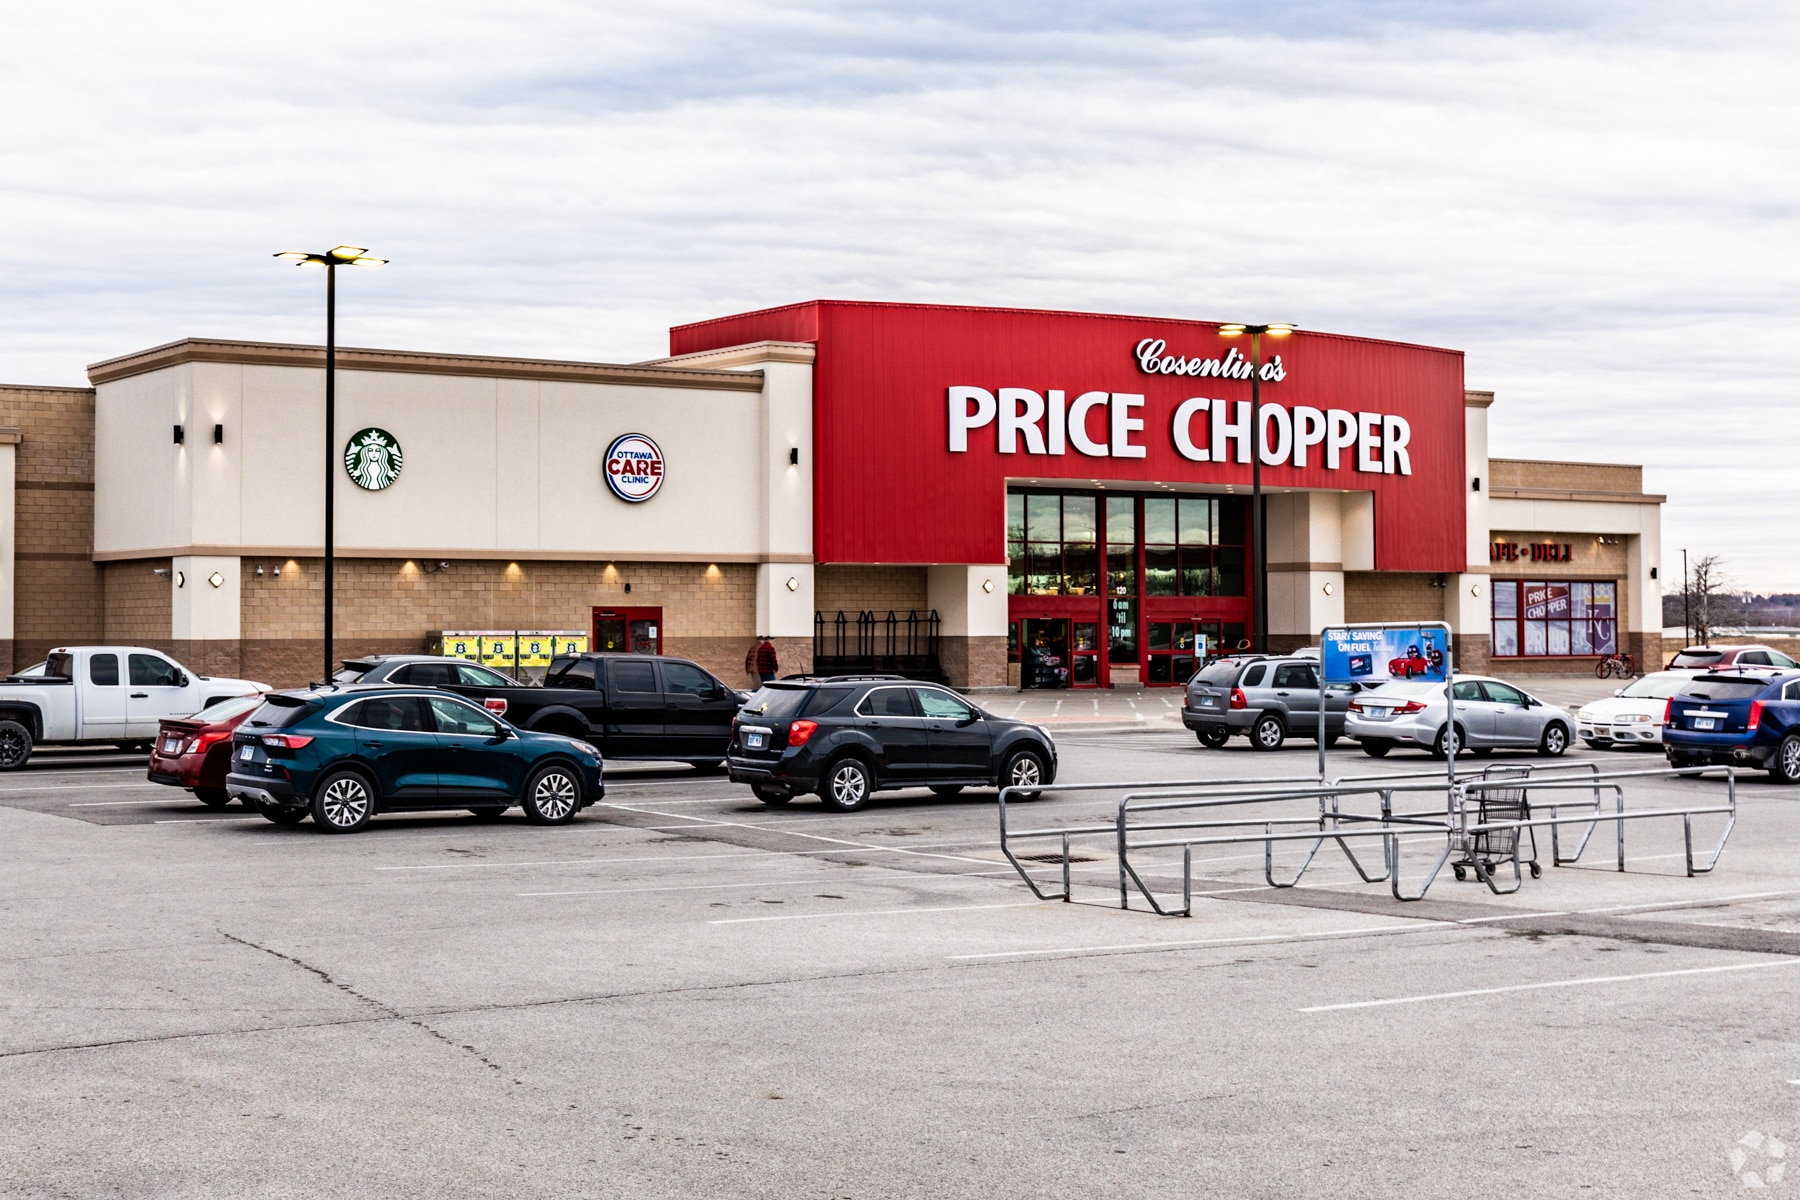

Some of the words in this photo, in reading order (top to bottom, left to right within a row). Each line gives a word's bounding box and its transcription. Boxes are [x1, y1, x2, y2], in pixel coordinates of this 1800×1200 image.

[1136, 338, 1287, 382] Cosentino's
[948, 385, 1147, 458] PRICE
[1173, 396, 1412, 476] CHOPPER
[617, 451, 653, 459] OTTAWA
[607, 458, 662, 476] CARE
[1531, 543, 1573, 561] DELI
[1113, 598, 1118, 610] 6
[1117, 601, 1129, 610] am
[1111, 625, 1120, 638] 10
[1120, 629, 1132, 641] pm
[1328, 631, 1351, 641] START
[1352, 631, 1383, 641] SAVING
[1338, 642, 1350, 652] ON
[1351, 642, 1372, 652] FUEL
